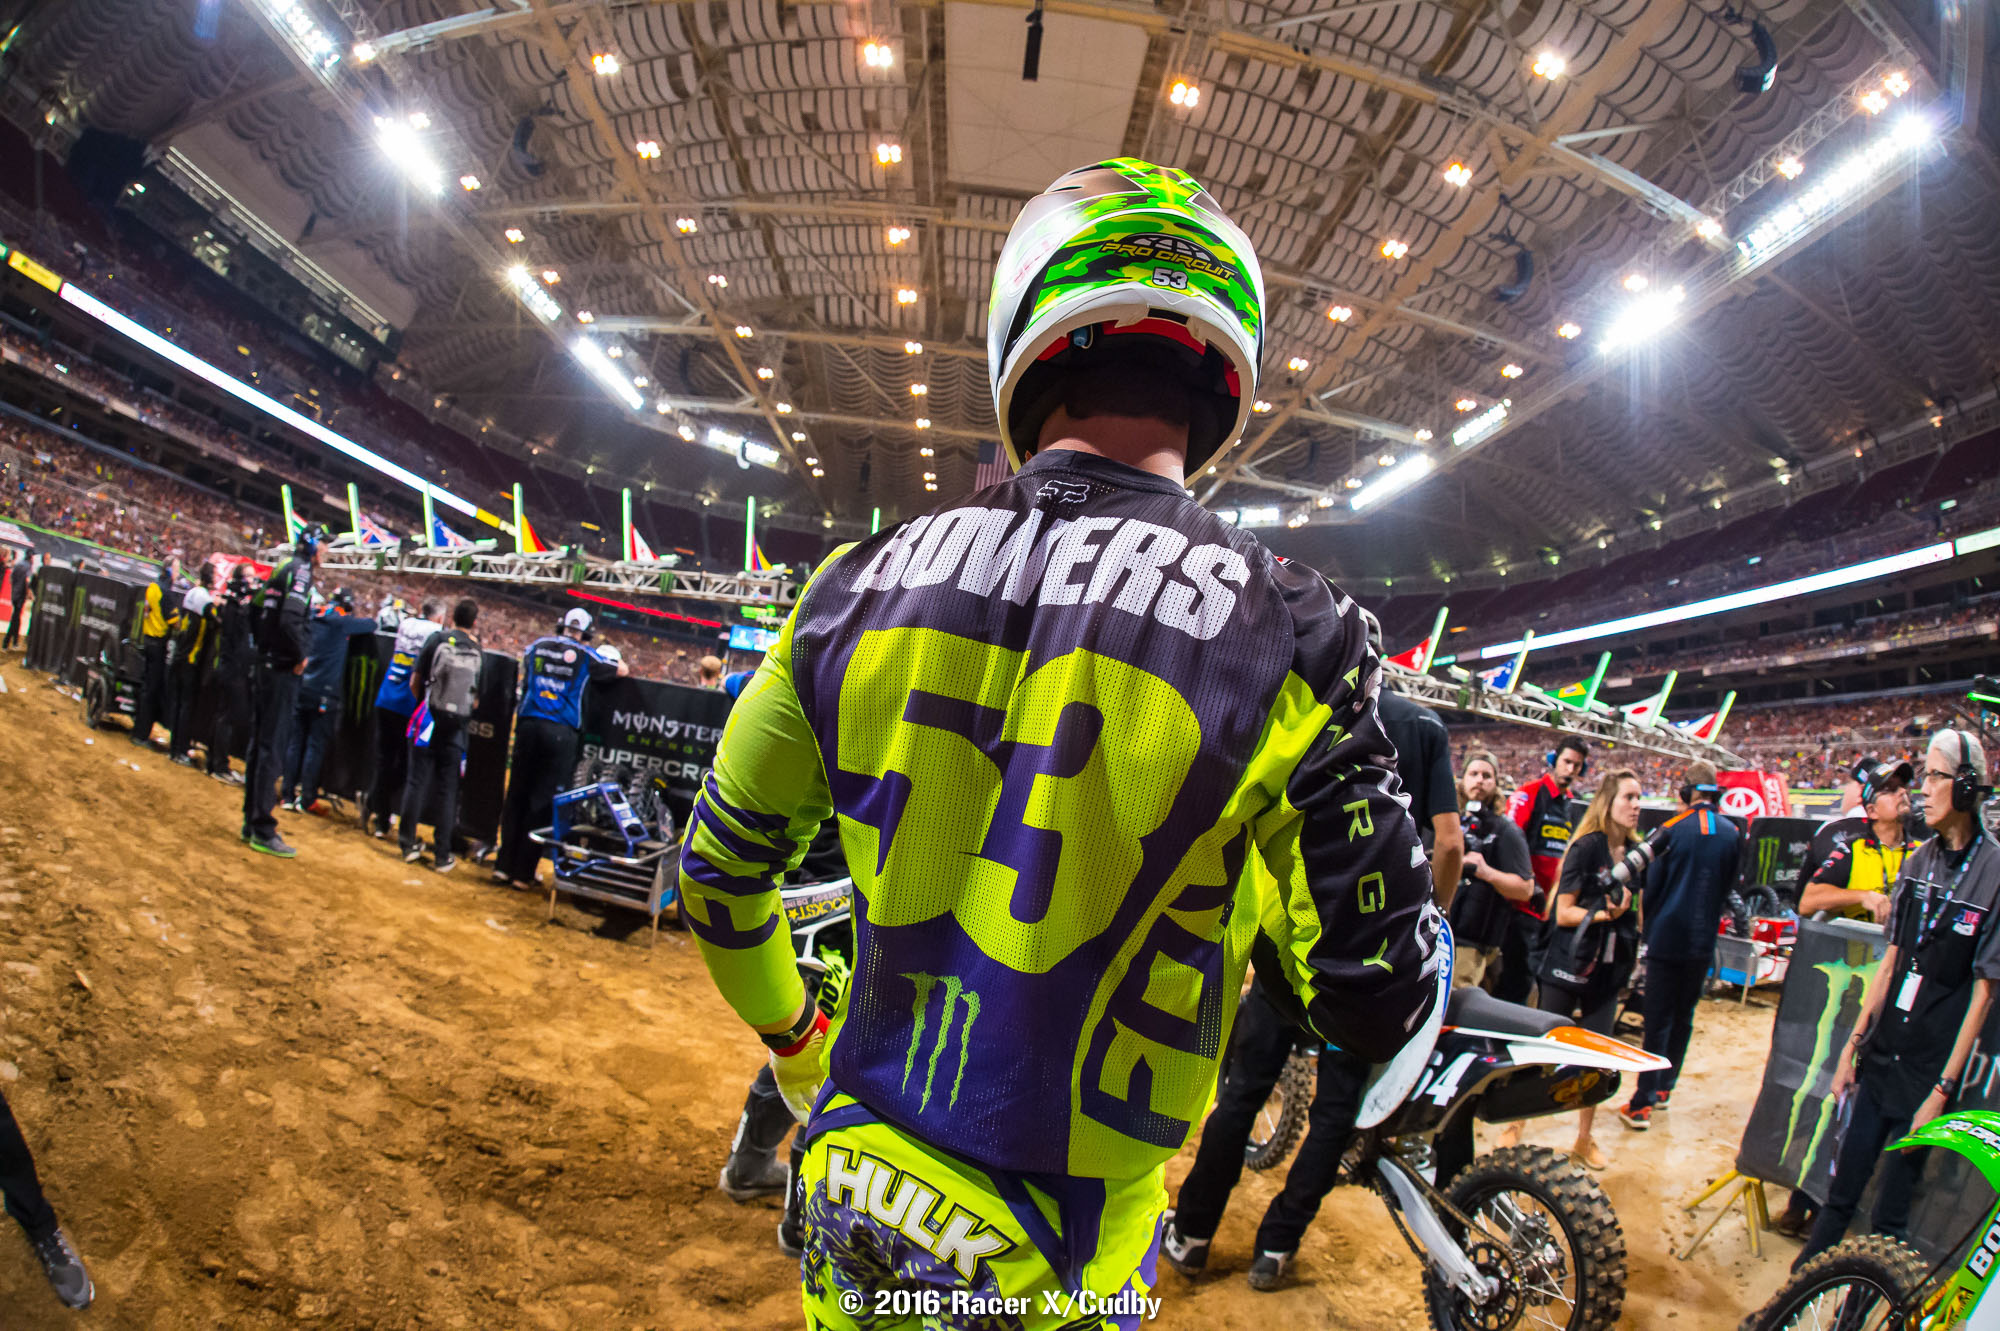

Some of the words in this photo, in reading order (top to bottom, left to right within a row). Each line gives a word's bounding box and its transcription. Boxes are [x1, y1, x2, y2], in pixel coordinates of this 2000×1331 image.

[1100, 242, 1154, 257] PRO
[1154, 249, 1236, 280] CIRCUIT
[1153, 267, 1188, 290] 53
[850, 506, 1251, 641] BOWERS
[837, 627, 1202, 974] 53
[827, 1146, 1013, 1283] HULK
